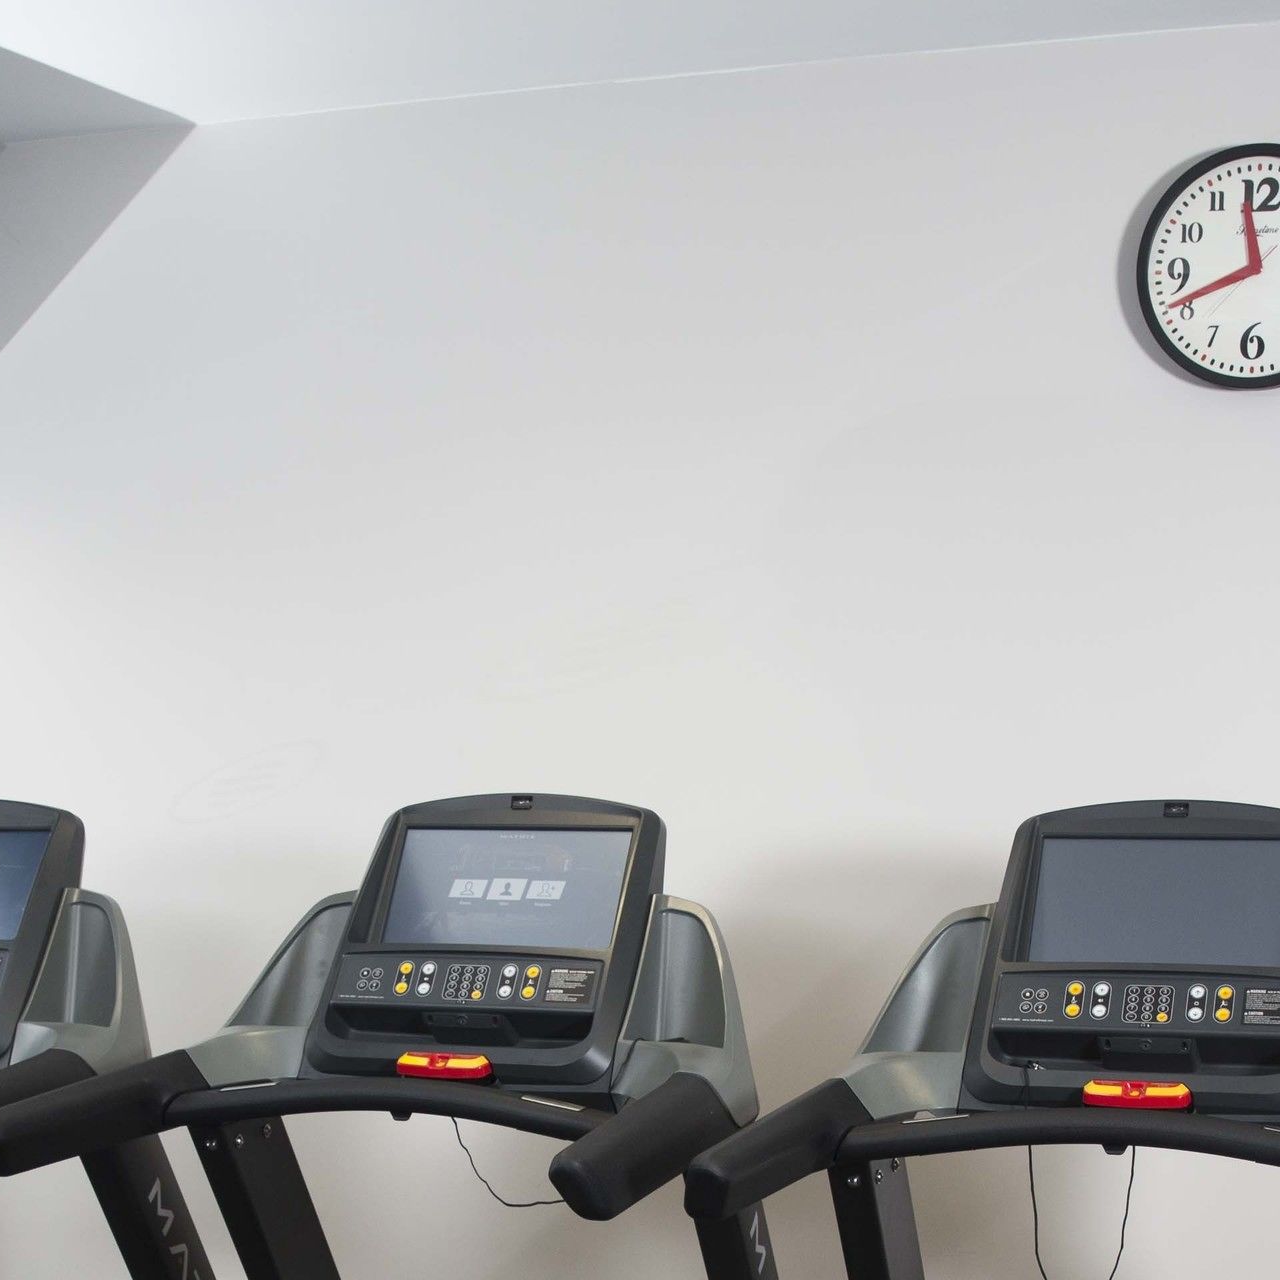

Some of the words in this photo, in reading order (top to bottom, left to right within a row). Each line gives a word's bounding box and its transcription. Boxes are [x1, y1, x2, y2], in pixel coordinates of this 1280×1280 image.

[1209, 190, 1225, 211] 11
[1180, 222, 1203, 243] 10
[1167, 257, 1191, 295] 9
[1179, 299, 1195, 321] 8
[1207, 325, 1219, 348] 7
[1239, 322, 1265, 360] 6
